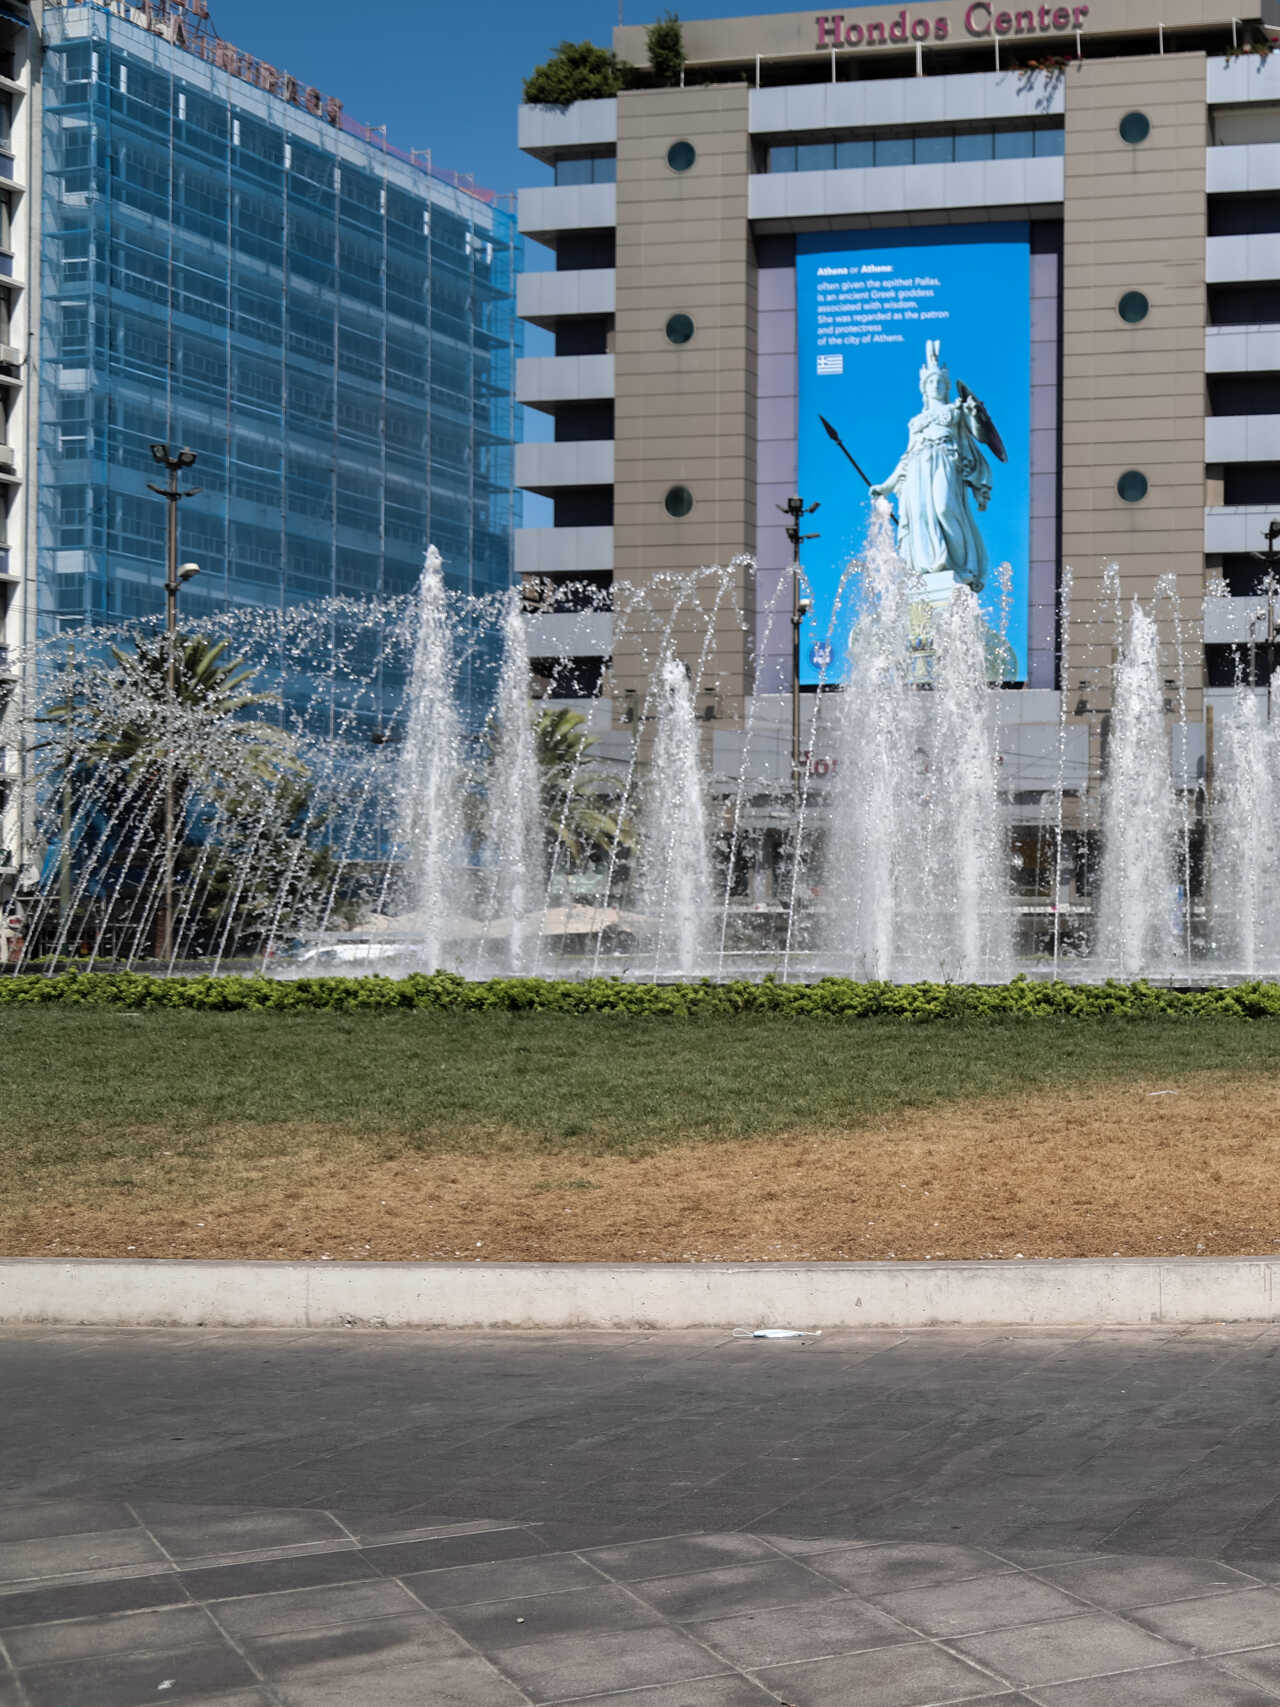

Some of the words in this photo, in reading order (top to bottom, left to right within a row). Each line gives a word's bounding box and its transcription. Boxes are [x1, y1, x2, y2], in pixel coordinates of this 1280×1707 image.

[816, 10, 949, 49] Hondos
[965, 1, 1089, 37] Center
[849, 266, 859, 275] or
[817, 281, 840, 291] often
[841, 280, 865, 292] given
[866, 279, 881, 288] the
[882, 278, 912, 288] epithet
[817, 293, 825, 302] is
[826, 294, 838, 302] an
[838, 291, 869, 301] ancient
[870, 289, 896, 299] Greek
[897, 289, 935, 300] goddess
[817, 302, 862, 313] associated
[863, 300, 882, 310] with
[883, 300, 918, 310] wisdom.
[817, 314, 833, 324] She
[835, 315, 851, 323] was
[852, 311, 892, 323] regarded
[893, 312, 903, 320] as
[904, 311, 919, 319] the
[920, 310, 950, 320] patron
[817, 326, 834, 335] and
[835, 324, 882, 335] protectress
[817, 336, 827, 345] of
[828, 336, 843, 345] the
[844, 335, 860, 346] city
[861, 334, 872, 343] of
[873, 334, 905, 342] Athens.
